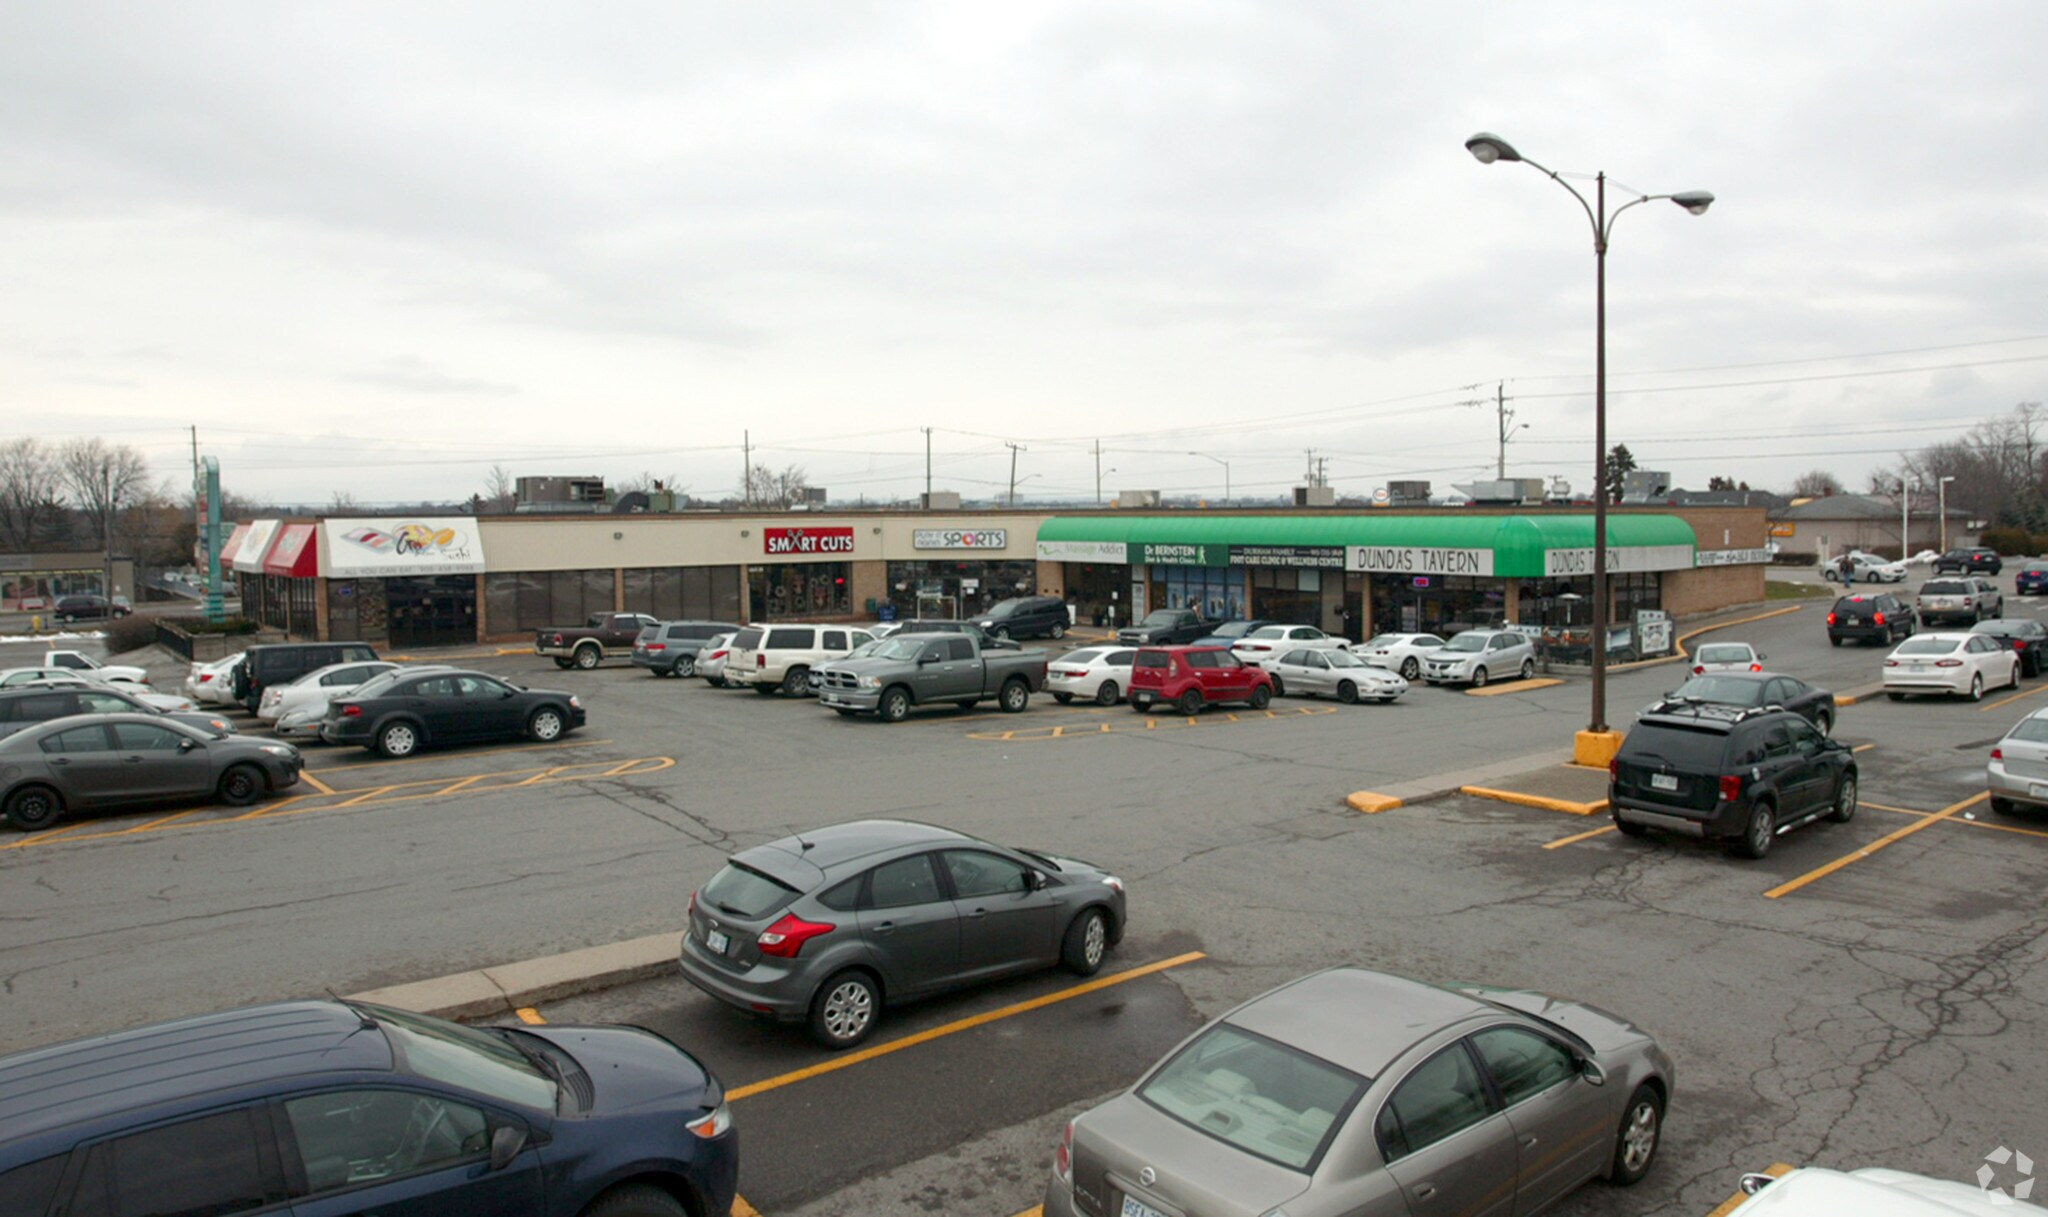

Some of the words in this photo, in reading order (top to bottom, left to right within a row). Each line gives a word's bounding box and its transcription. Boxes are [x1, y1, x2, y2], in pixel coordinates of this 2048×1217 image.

[820, 536, 853, 551] CUTS
[943, 531, 1004, 547] SPORTS
[1098, 543, 1124, 555] Addict
[1155, 545, 1196, 556] BERNSTEIN
[1245, 555, 1260, 565] CARE
[1287, 556, 1318, 566] WELLNESS
[1358, 549, 1413, 570] DUNDAS
[1421, 550, 1479, 573] TAVERN
[1552, 551, 1585, 573] DUNDAS
